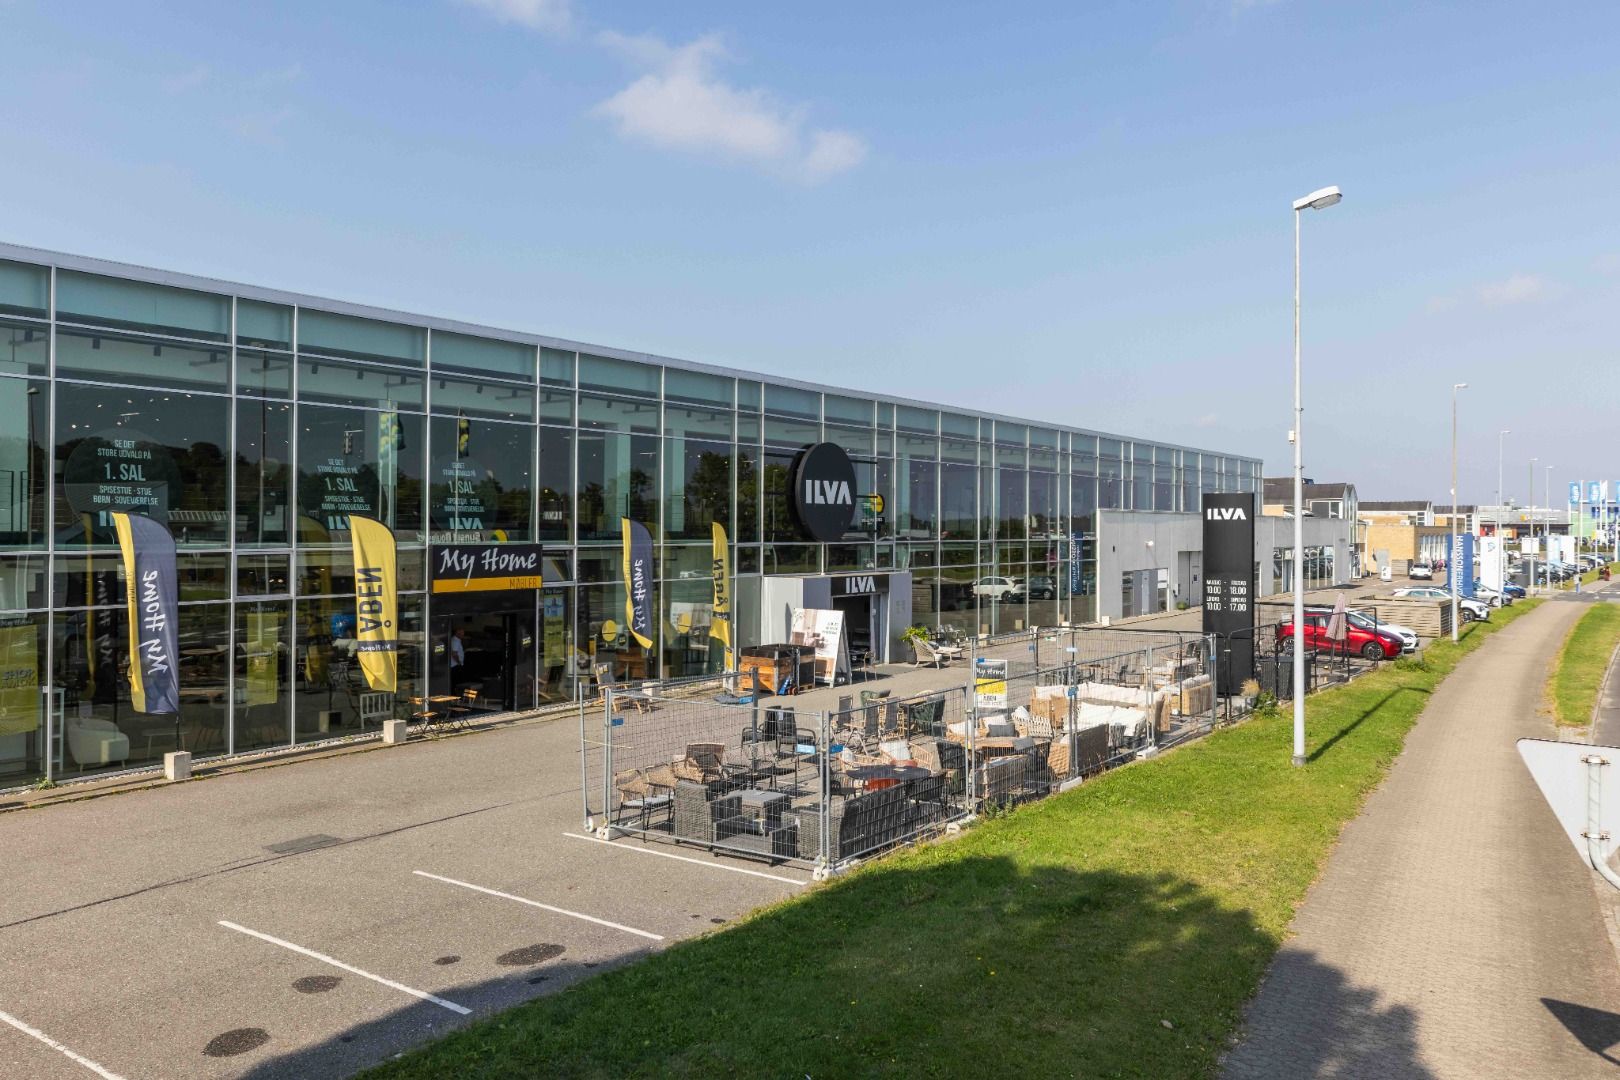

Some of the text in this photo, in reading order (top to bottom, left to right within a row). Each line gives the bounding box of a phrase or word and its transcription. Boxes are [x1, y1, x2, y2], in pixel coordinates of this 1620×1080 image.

[114, 439, 135, 449] SE DET
[97, 447, 118, 457] STORE
[104, 462, 147, 481] 1. SAL
[99, 485, 153, 496] SPISESTUE STUE
[324, 476, 359, 492] 1. SAL
[457, 480, 475, 494] SAL
[805, 479, 852, 505] ILVA
[114, 496, 159, 506] SOVEVÆRELSE
[1206, 507, 1247, 520] ILVA
[328, 515, 351, 530] ILV
[448, 517, 484, 530] ILVA
[440, 547, 537, 588] My Home
[845, 575, 876, 594] ILVA
[1229, 586, 1247, 595] 18.00
[1229, 603, 1247, 612] 17.00
